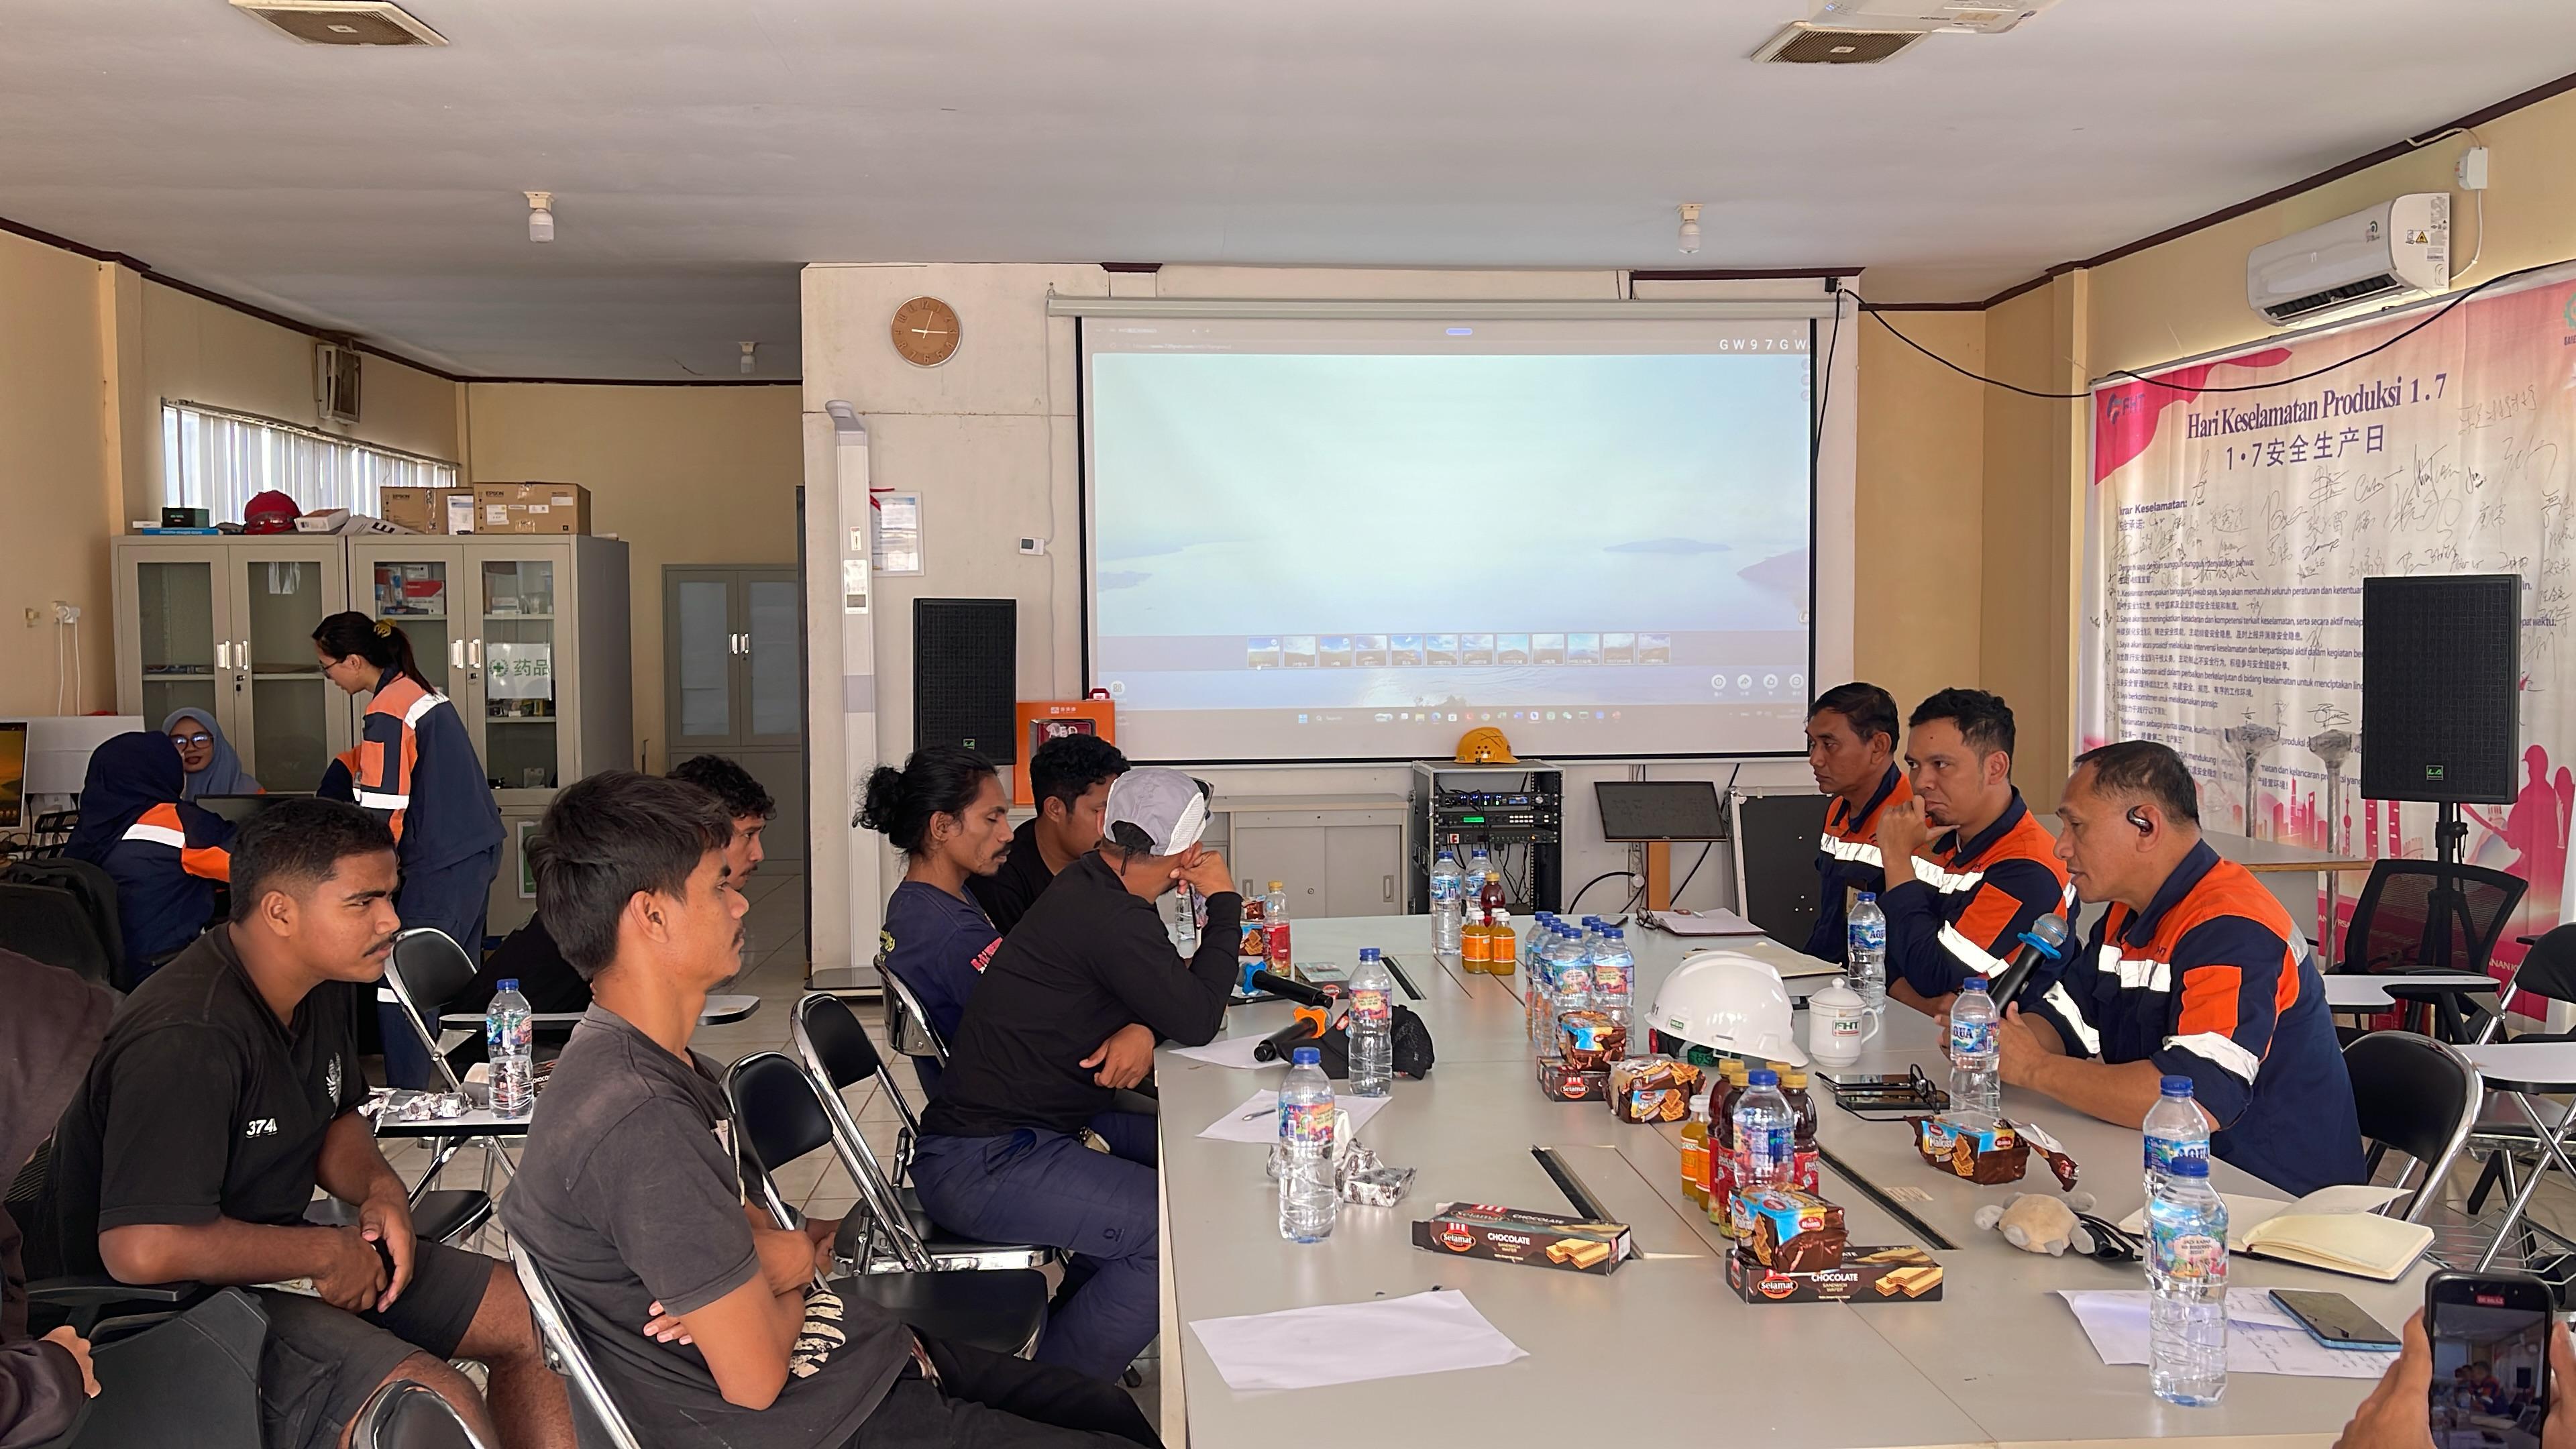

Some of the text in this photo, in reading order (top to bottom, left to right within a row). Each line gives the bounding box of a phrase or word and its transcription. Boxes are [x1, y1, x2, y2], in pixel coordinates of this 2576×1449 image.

[2187, 410, 2218, 439] Hari
[2221, 398, 2318, 435] Keselamatan
[2321, 376, 2402, 419] Produksi
[2135, 500, 2187, 513] Keselamatan:
[2244, 587, 2270, 596] mematuhi
[2292, 587, 2320, 597] peraturan
[2321, 586, 2332, 595] dan
[2330, 616, 2343, 625] aktif
[2327, 648, 2352, 659] kegiatan
[513, 658, 550, 677] 药品
[2238, 674, 2243, 682] di
[2244, 674, 2261, 684] bidang
[2263, 674, 2296, 684] keselamatan
[2297, 678, 2313, 686] untuk
[2314, 679, 2352, 690] menciptakan
[2278, 765, 2289, 774] dan
[1870, 929, 1886, 939] AQU
[1953, 1026, 1974, 1038] QUA
[246, 1118, 277, 1136] 374
[1512, 1214, 1565, 1224] CHOCOLATE
[1443, 1234, 1472, 1244] Selamat
[1487, 1232, 1530, 1245] CHOCOLATE
[1811, 1273, 1858, 1283] CHOCOLATE
[1760, 1281, 1794, 1290] Selamat
